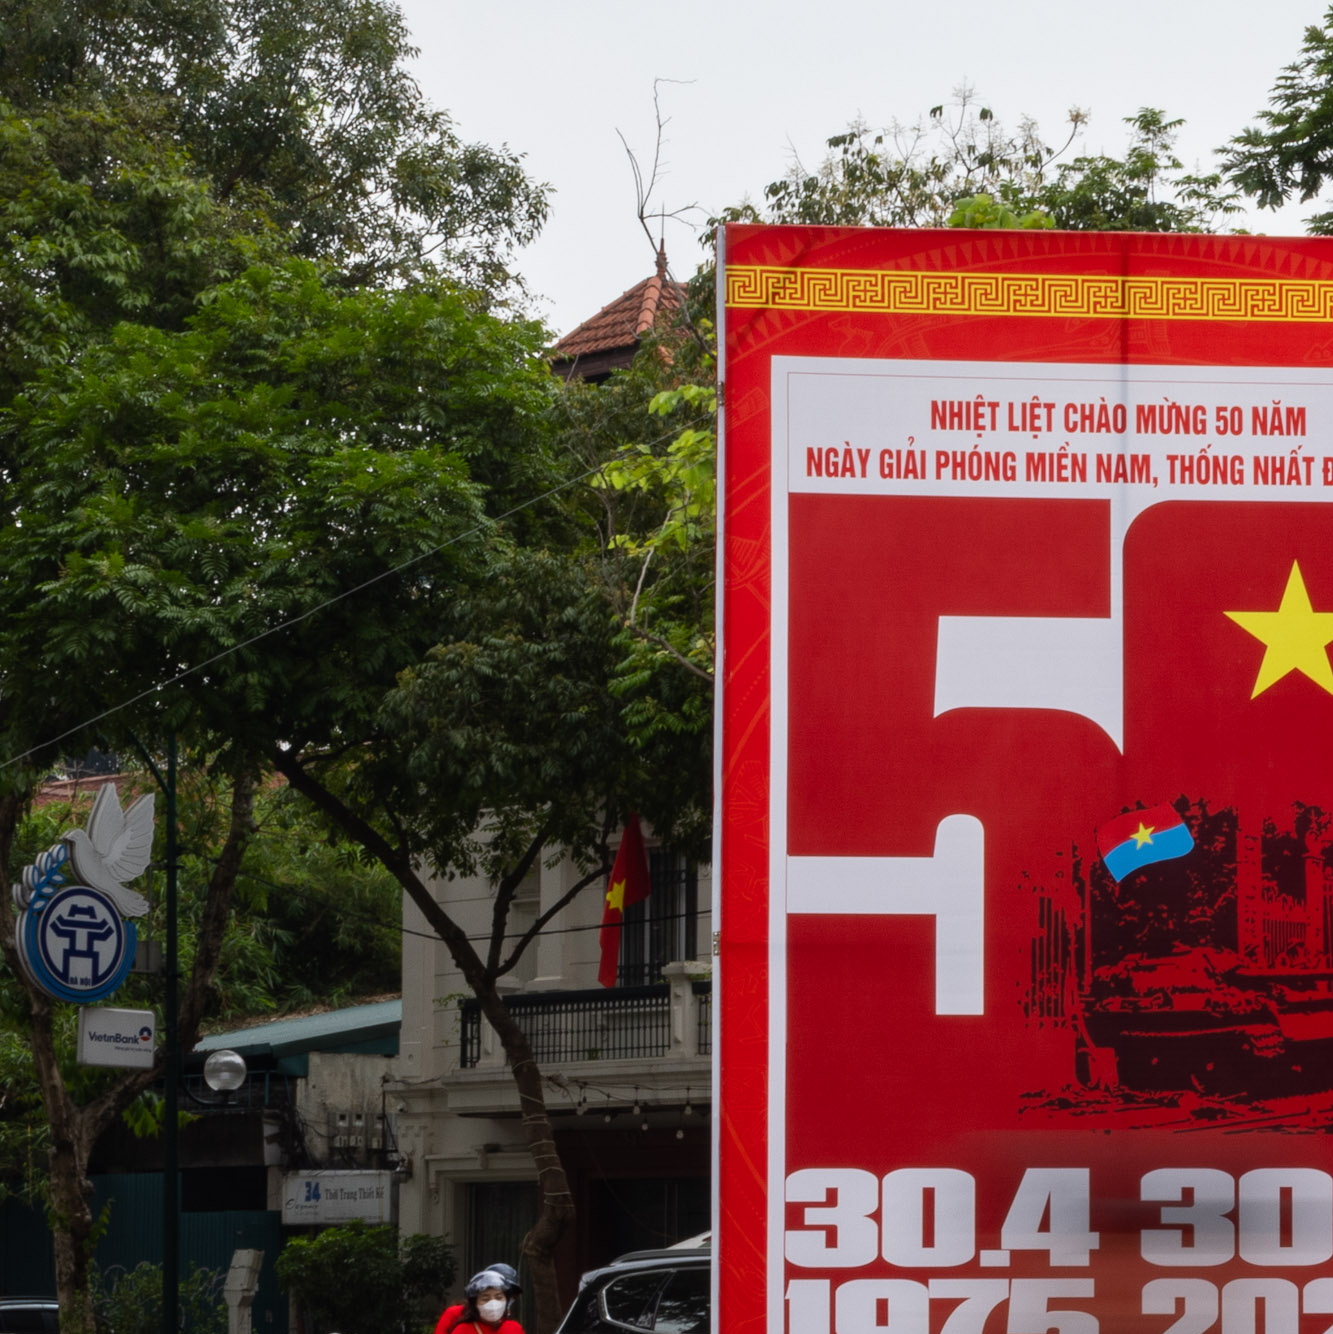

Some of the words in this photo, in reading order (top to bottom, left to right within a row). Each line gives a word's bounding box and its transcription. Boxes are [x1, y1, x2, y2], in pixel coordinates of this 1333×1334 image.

[931, 395, 999, 437] NHIỆT
[1008, 396, 1055, 438] LIỆT
[1064, 397, 1127, 433] CHÀO
[1136, 397, 1207, 435] MỪNG
[1215, 406, 1243, 435] 50
[1252, 400, 1306, 436] NĂM
[806, 441, 871, 478] NGÀY
[879, 436, 926, 479] GIẢI
[935, 444, 1016, 481] PHÓNG
[1026, 442, 1087, 482] MIỀN
[1096, 453, 1158, 487] NAM,
[1166, 444, 1244, 485] THỐNG
[1253, 445, 1315, 486] NHẤT
[304, 1181, 321, 1202] 34
[785, 1167, 1100, 1268] 30.4
